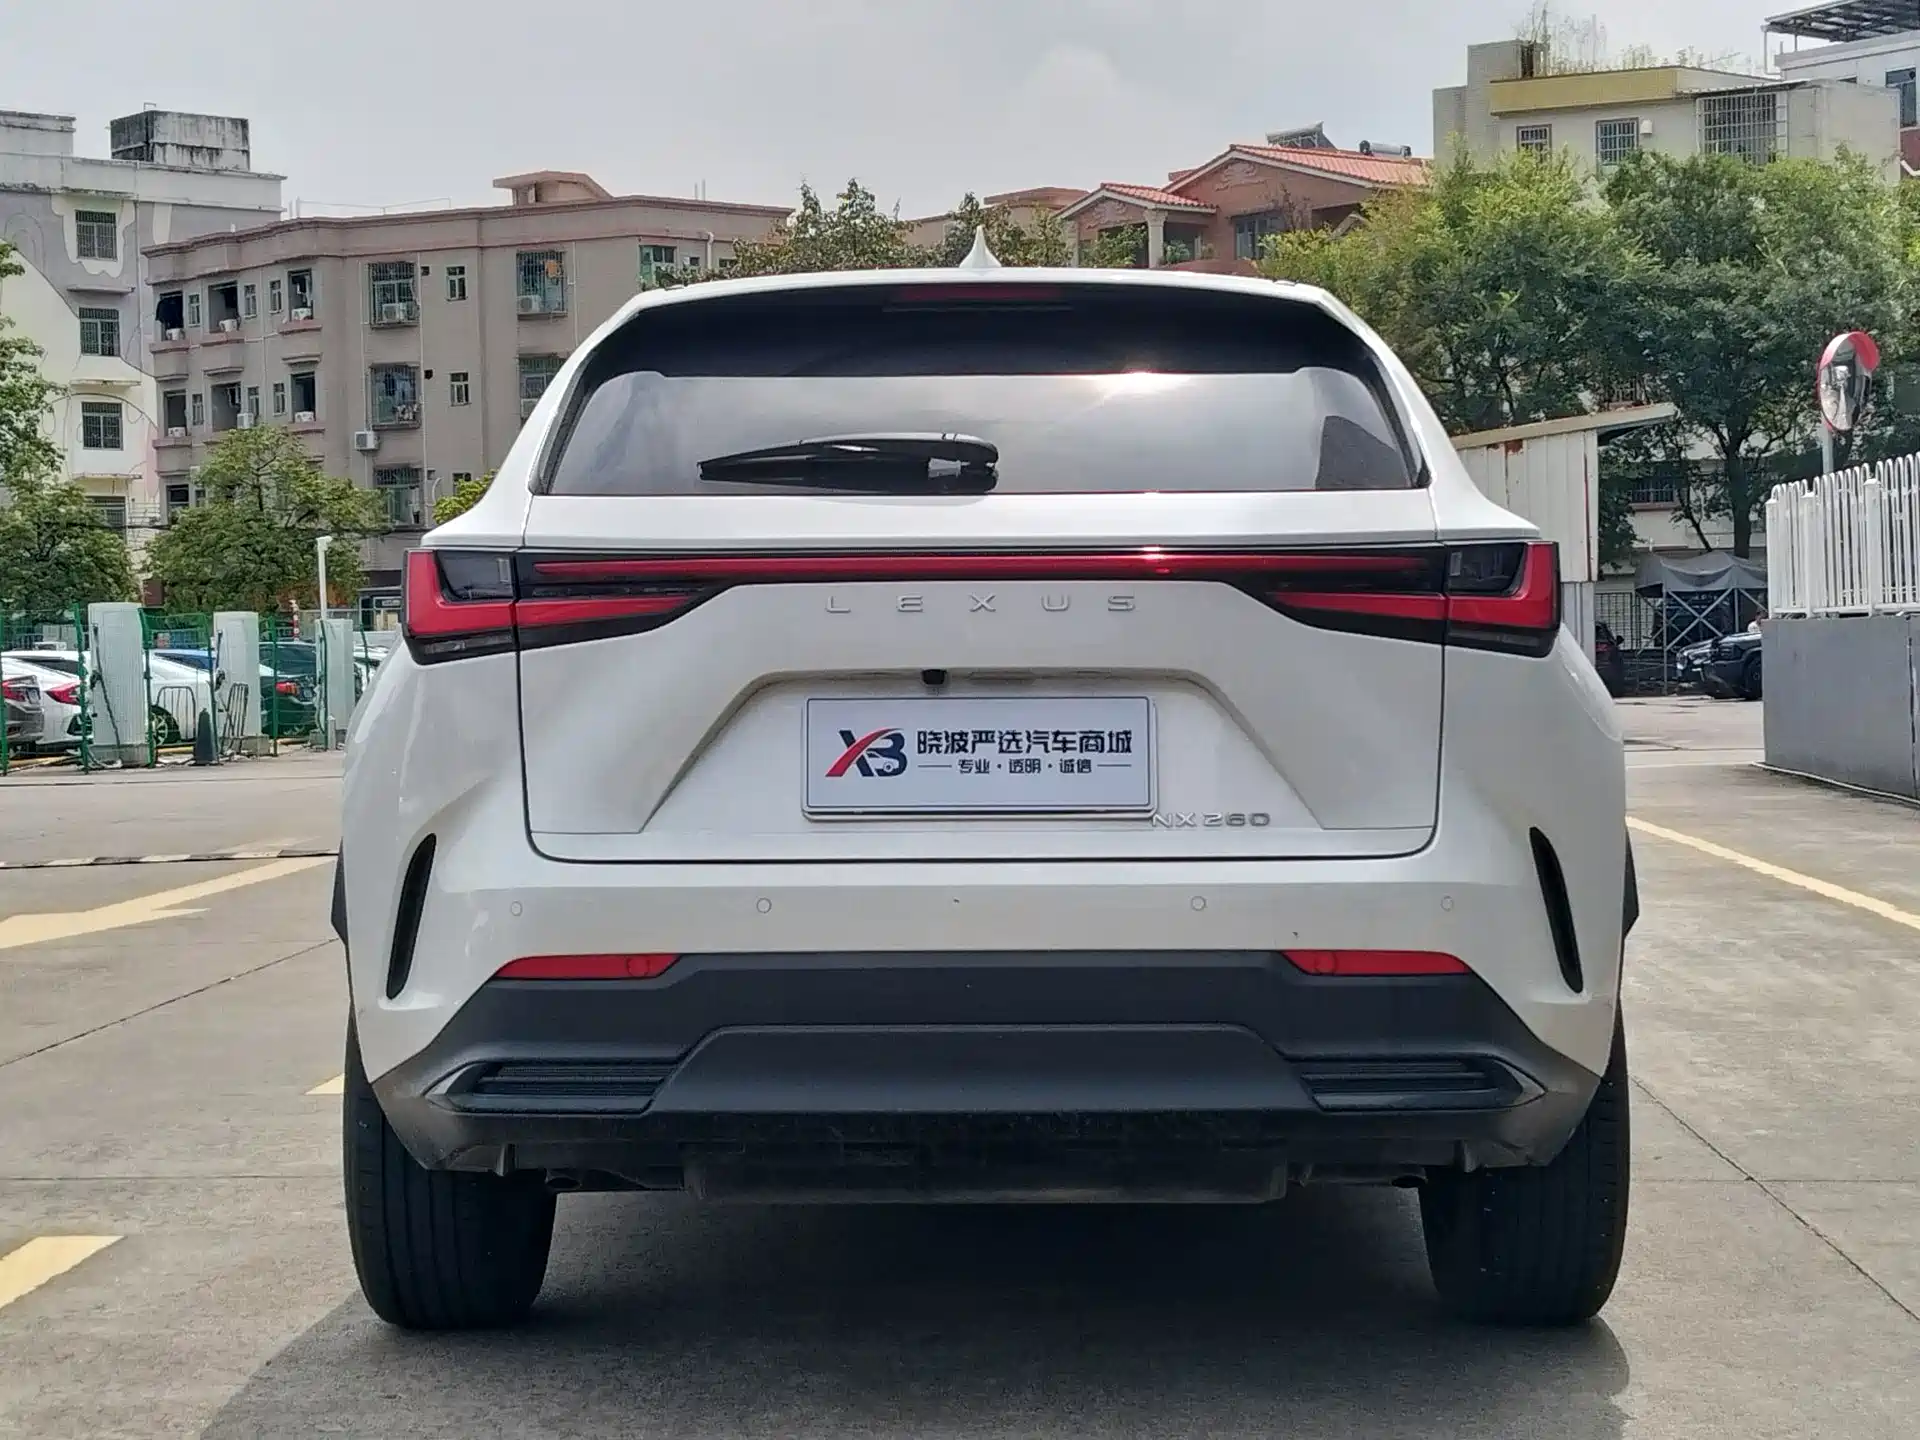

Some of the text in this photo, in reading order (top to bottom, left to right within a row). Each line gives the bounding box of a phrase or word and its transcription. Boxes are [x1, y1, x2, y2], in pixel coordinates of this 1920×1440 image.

[825, 595, 1136, 613] LEXUS
[916, 730, 1132, 754] 晓波严选汽车商城
[1152, 812, 1270, 828] NX 260
